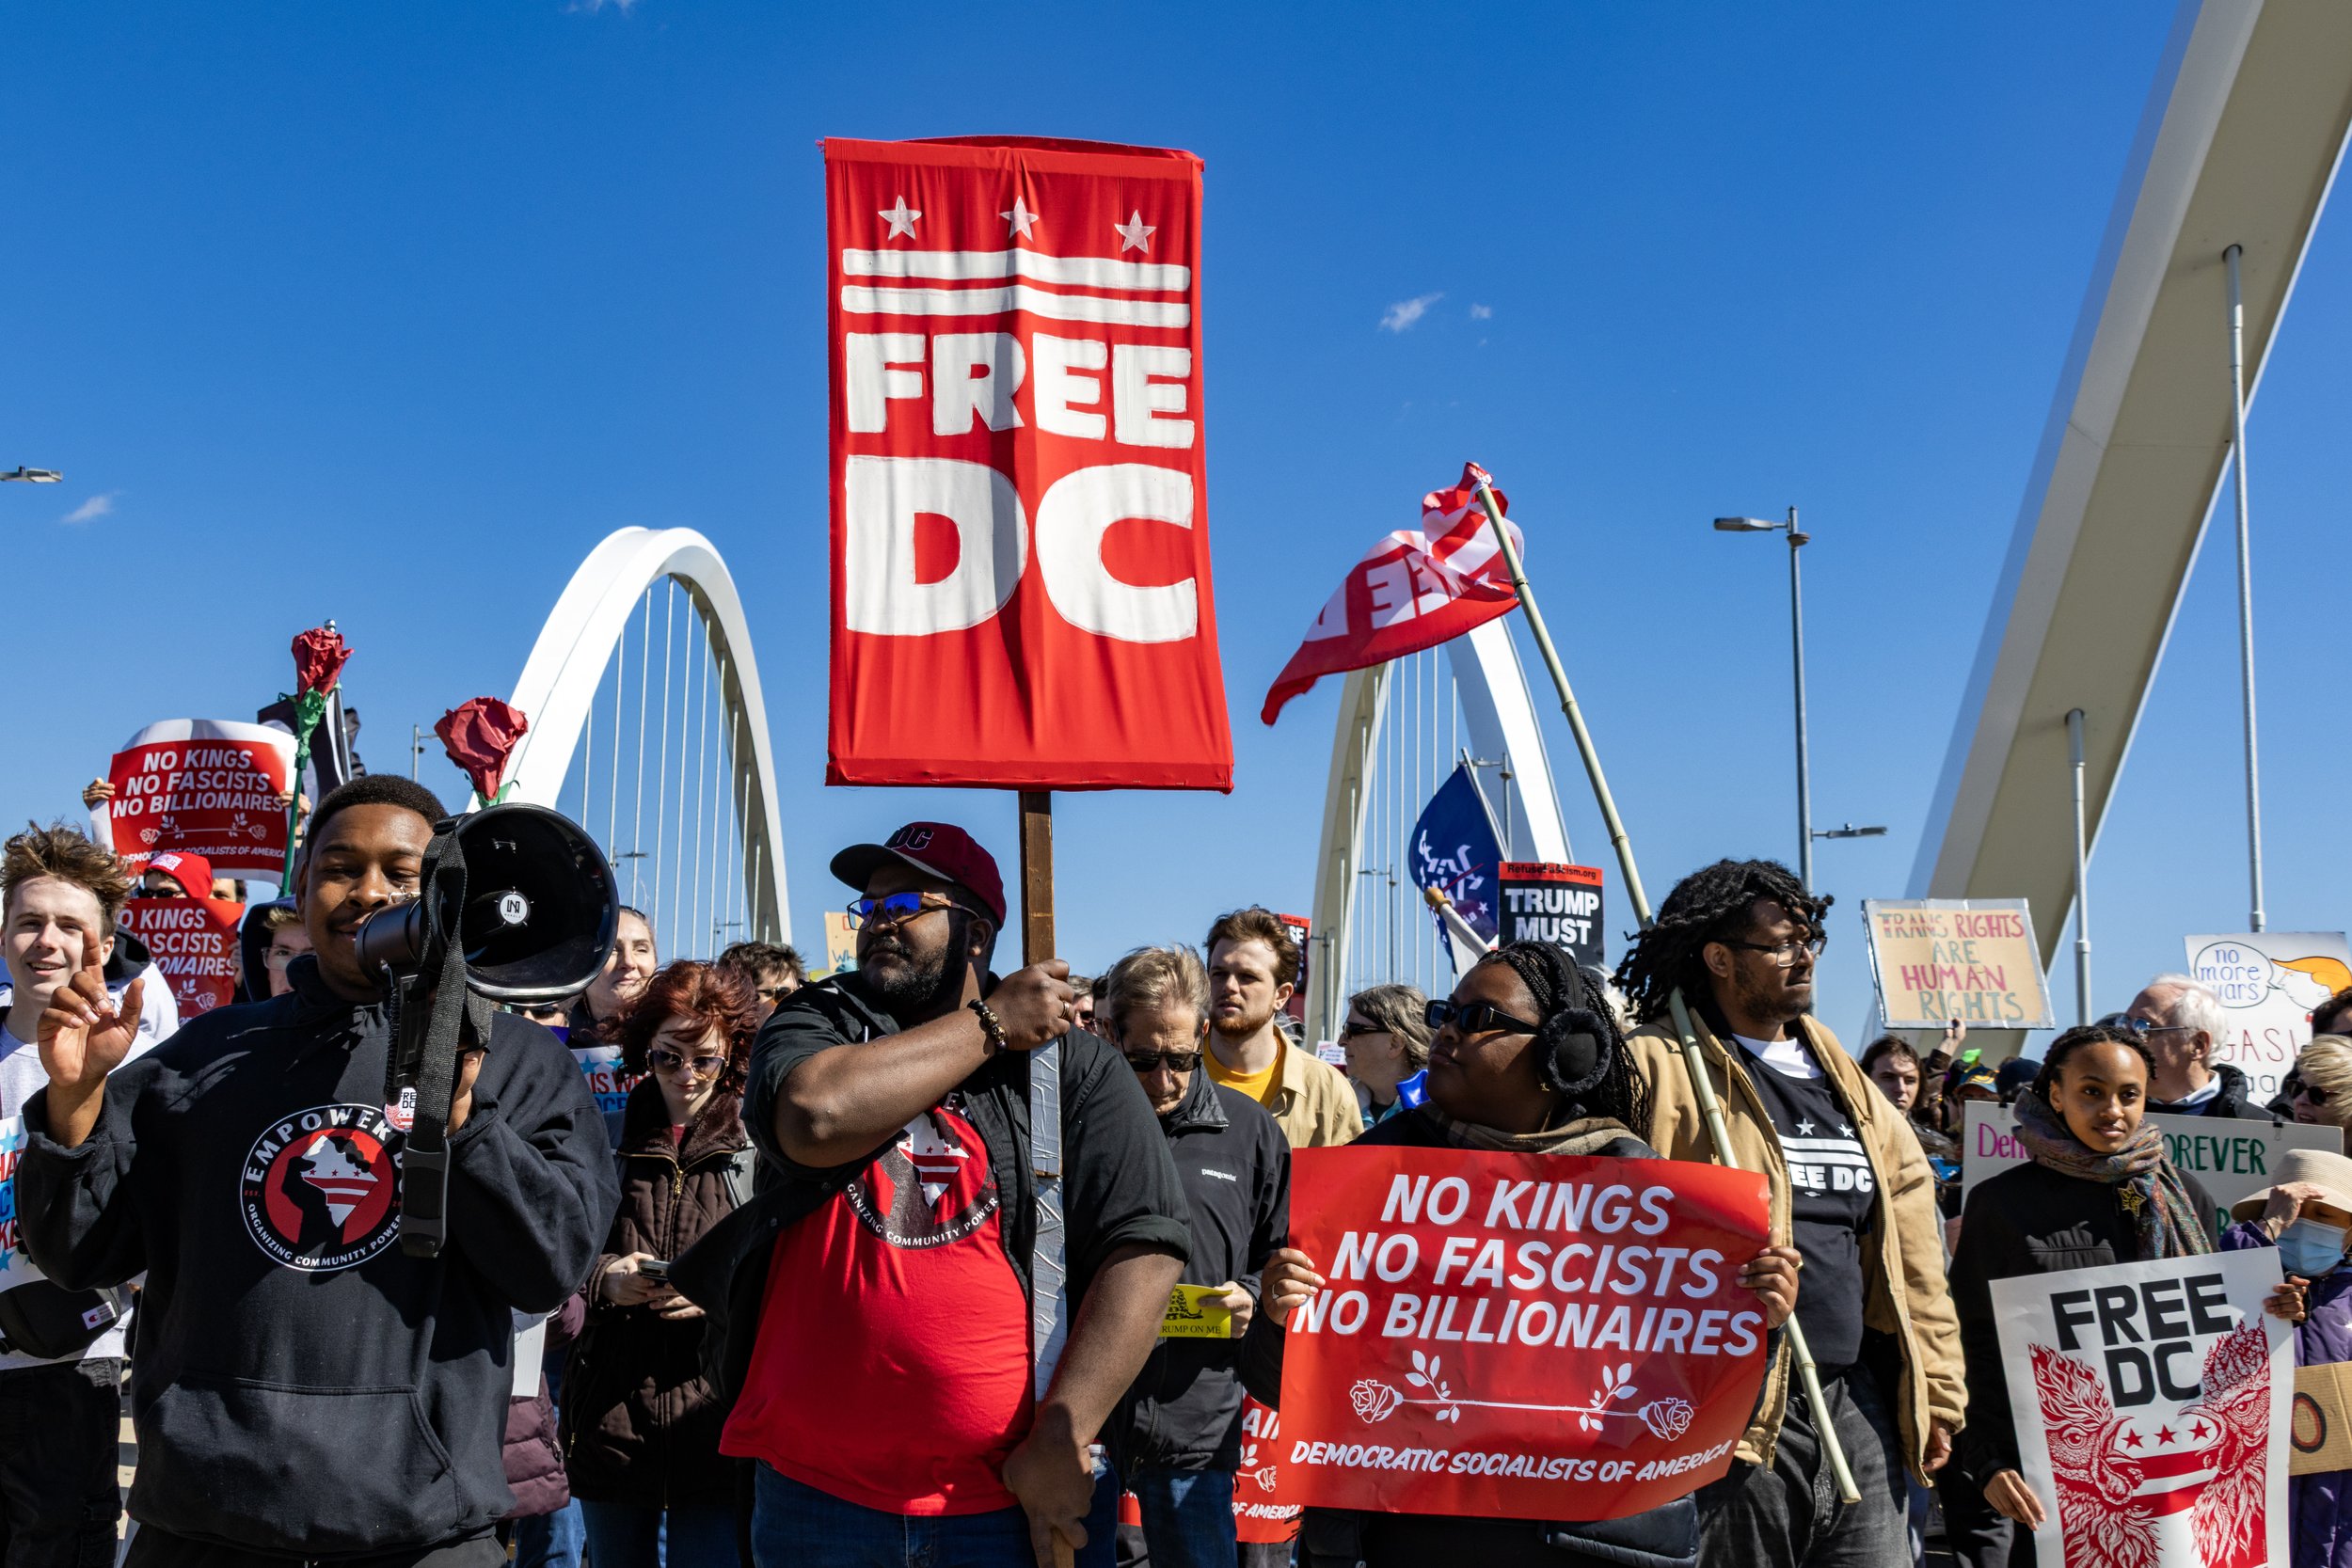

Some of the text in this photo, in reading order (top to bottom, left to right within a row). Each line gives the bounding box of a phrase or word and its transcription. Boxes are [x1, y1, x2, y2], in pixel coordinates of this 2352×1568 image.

[846, 332, 1195, 449] FREE
[846, 454, 1197, 643] DC
[143, 749, 253, 772] NO KINGS
[125, 770, 271, 796] NO FASCISTS
[112, 792, 283, 818] NO BILLIONAIRES
[883, 826, 934, 850] DC
[237, 846, 251, 856] OF
[250, 847, 285, 859] AMERICA
[1505, 888, 1599, 916] TRUMP
[119, 908, 207, 929] O KINGS
[1516, 917, 1592, 945] MUST
[1877, 913, 2026, 939] TRANS RIGHTS
[135, 932, 223, 954] ASCISTS
[1932, 941, 1980, 964] ARE
[2215, 949, 2240, 964] no
[1900, 964, 2007, 991] HUMAN
[2200, 966, 2262, 981] more
[1919, 990, 2025, 1022] RIGHTS
[2162, 1133, 2266, 1176] OREVER
[1788, 1164, 1873, 1193] EE DC
[847, 1183, 998, 1246] GANIZING COMMUNITY POWER
[1380, 1174, 1675, 1236] NO KINGS
[248, 1203, 294, 1259] ORGANIZING
[294, 1247, 367, 1267] COMMUNITY
[1329, 1231, 1724, 1299] NO FASCISTS
[1292, 1289, 1764, 1357] NO BILLIONAIRES
[2050, 1273, 2234, 1352] FREE
[1162, 1325, 1222, 1335] RUMP ON ME
[2104, 1340, 2201, 1408] DC
[1290, 1439, 1733, 1482] DEMOCRATIC SOCIALISTS OF AMERICA
[1246, 1504, 1301, 1520] AMERICA
